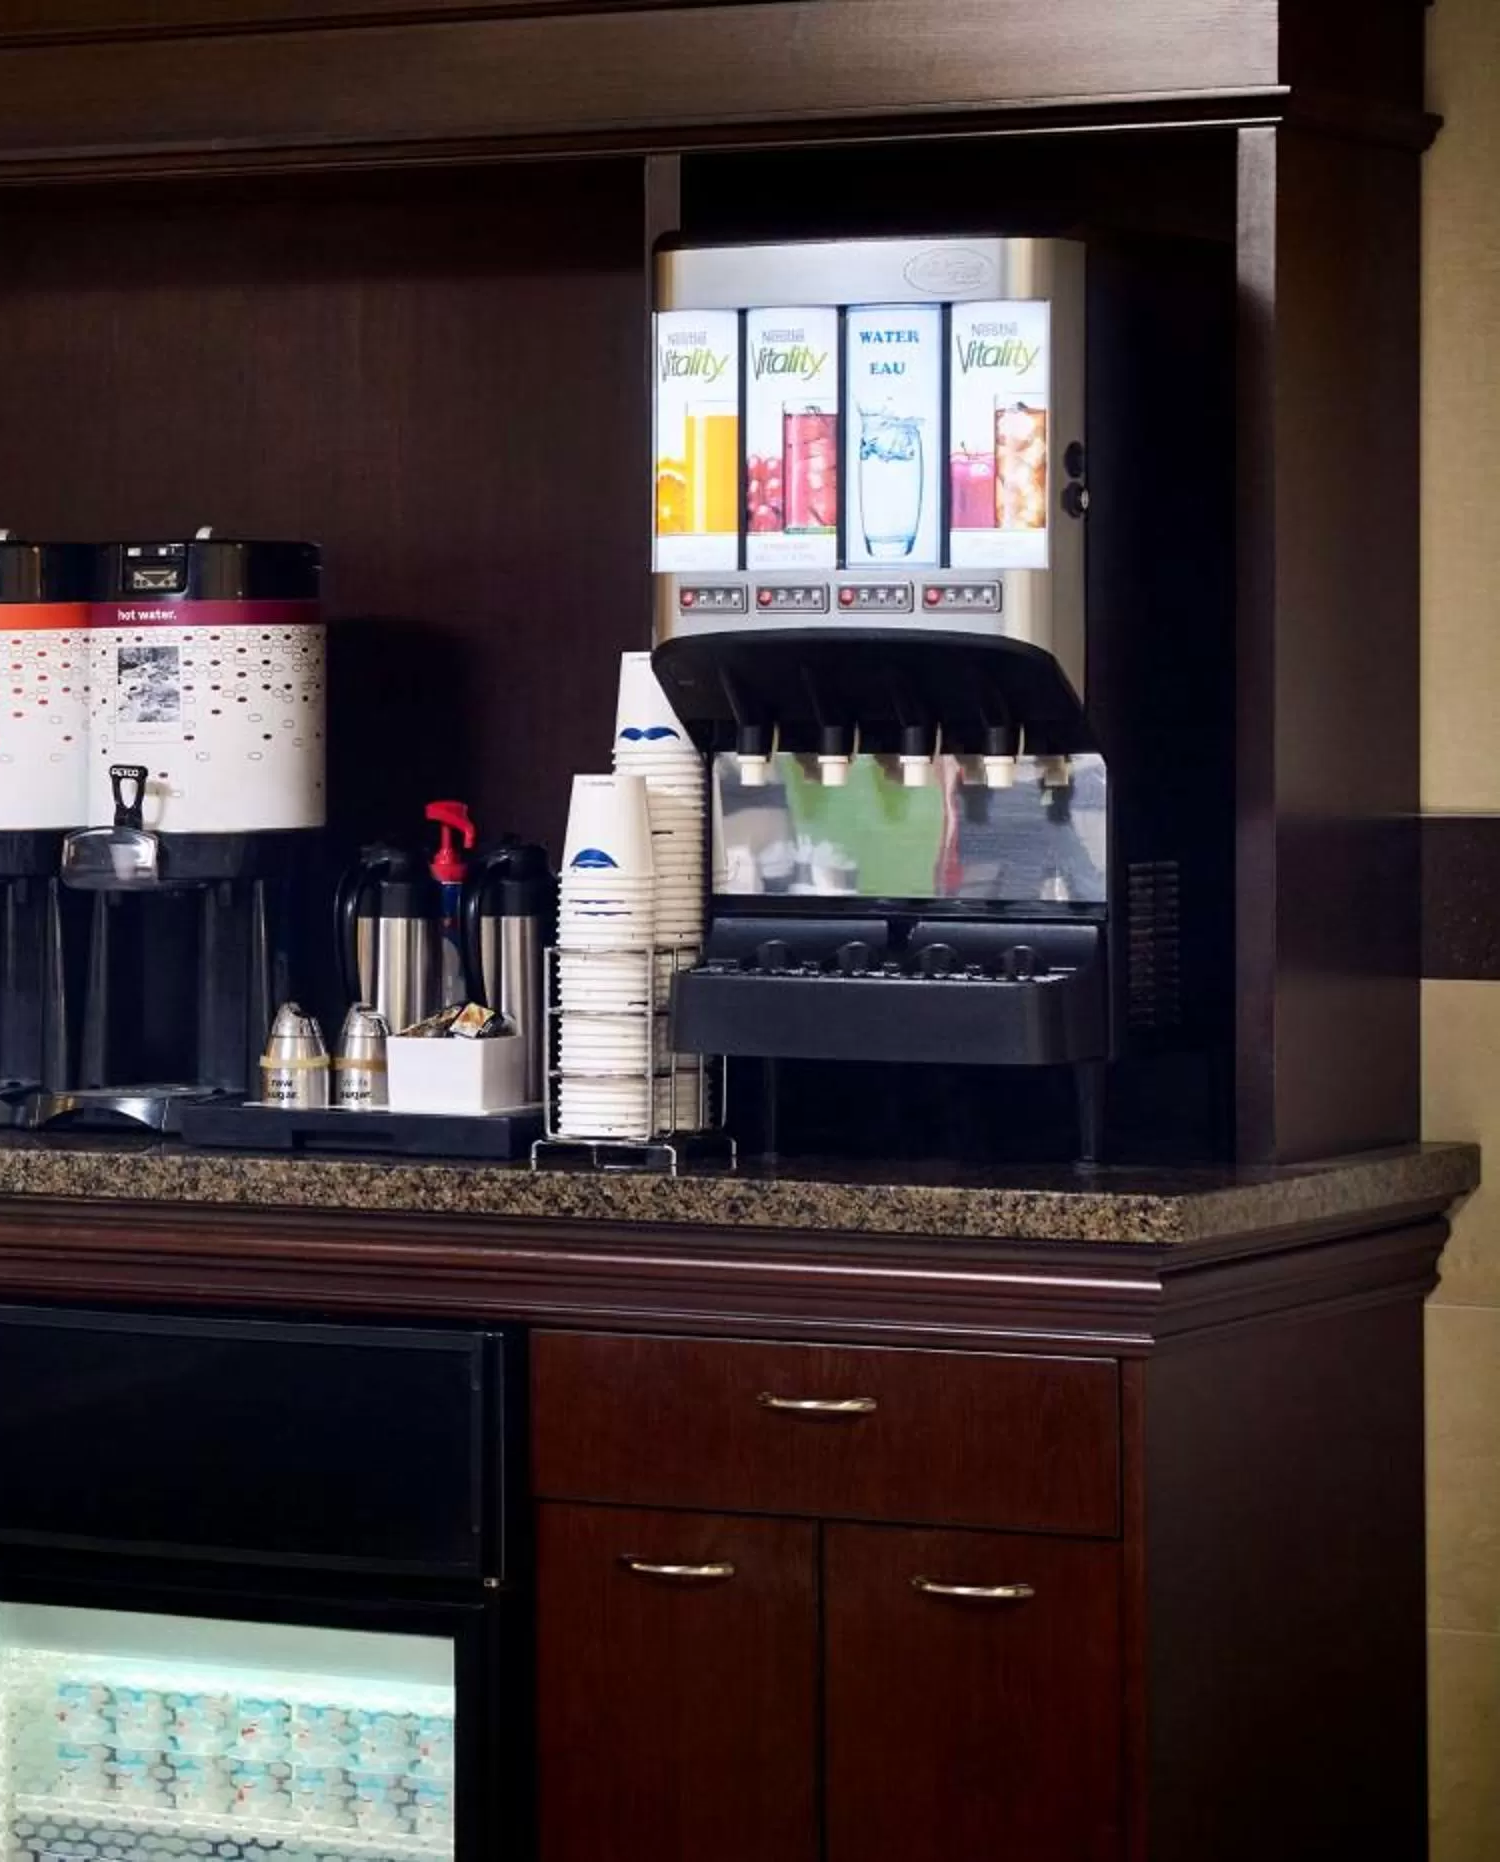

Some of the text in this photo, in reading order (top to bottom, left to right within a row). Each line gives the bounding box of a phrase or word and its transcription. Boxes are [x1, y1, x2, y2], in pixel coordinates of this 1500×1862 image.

[858, 329, 920, 344] WATER
[660, 344, 730, 383] Vitality
[750, 340, 829, 381] Vitality
[955, 333, 1040, 375] Vitality
[869, 360, 906, 376] EAU
[117, 608, 136, 621] hot
